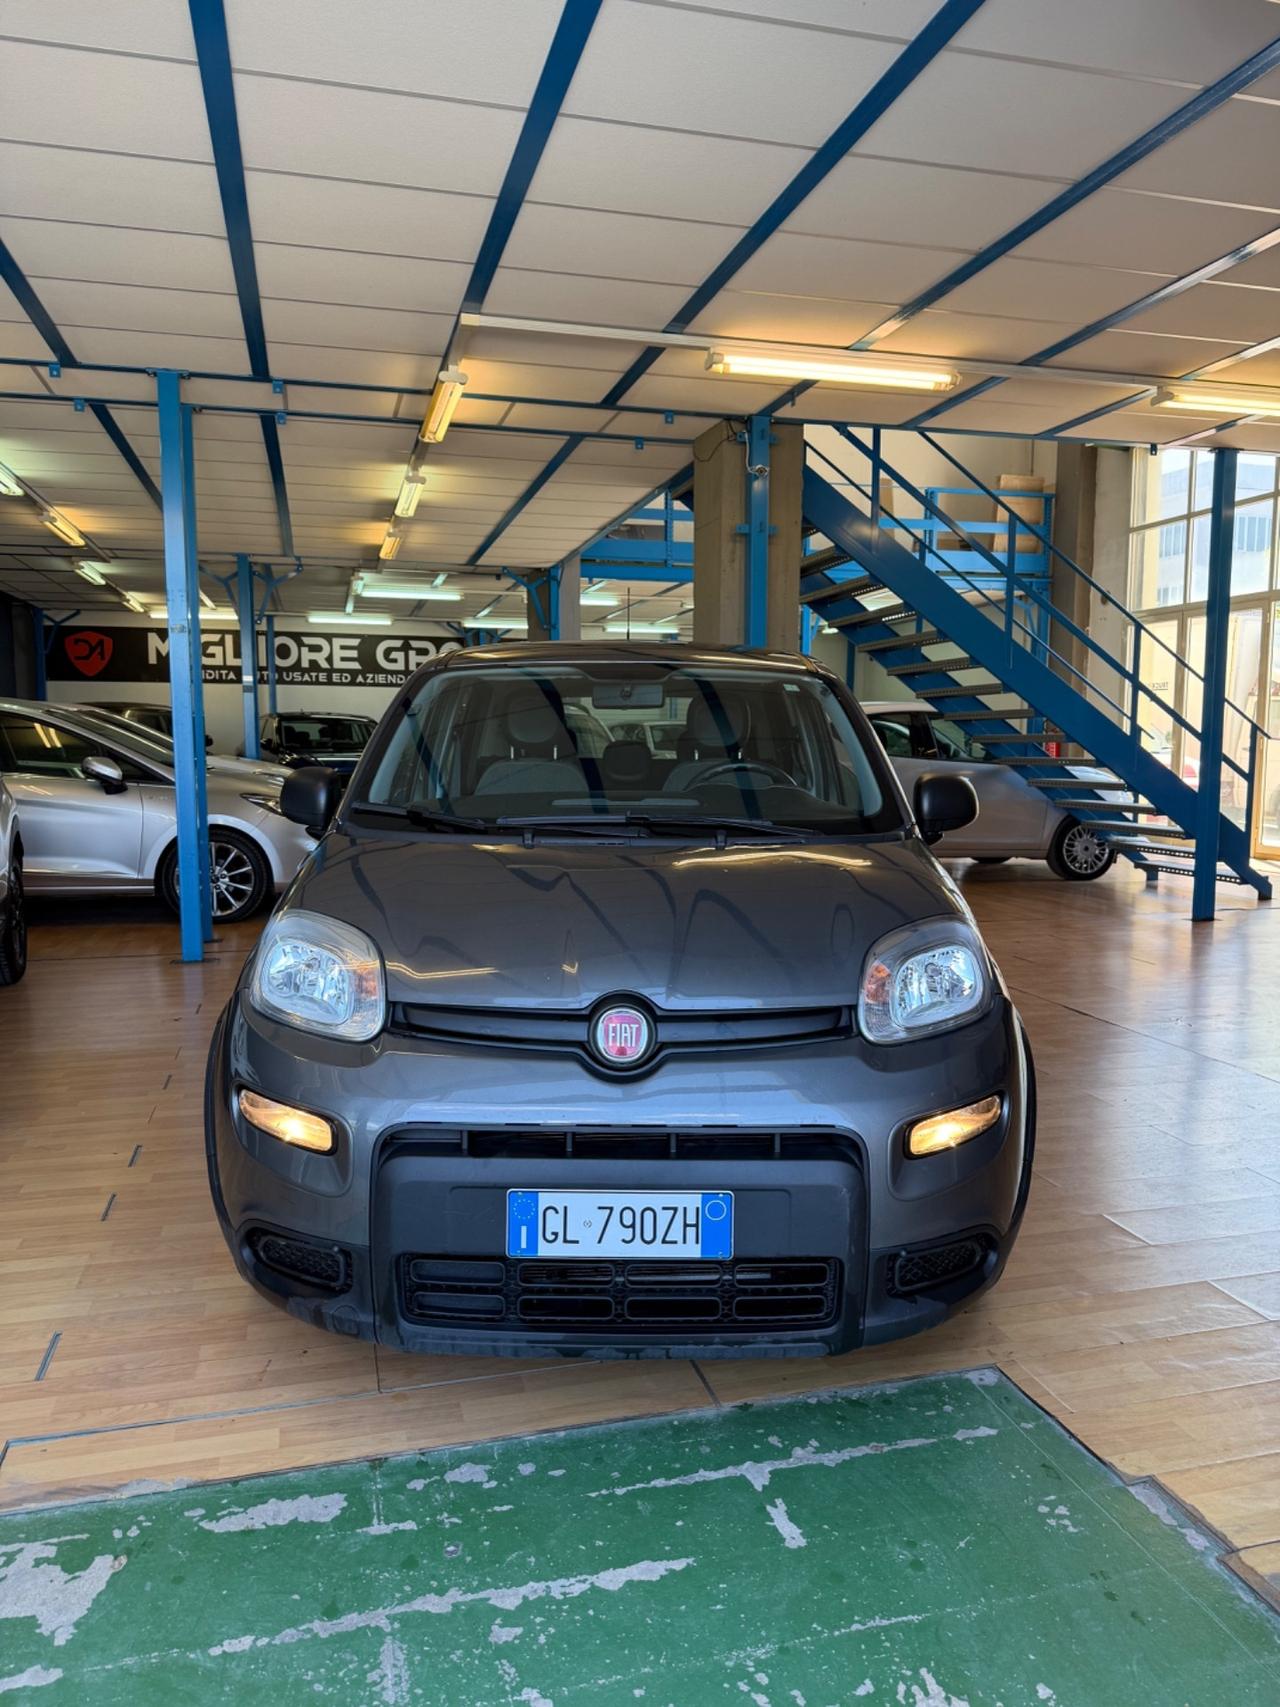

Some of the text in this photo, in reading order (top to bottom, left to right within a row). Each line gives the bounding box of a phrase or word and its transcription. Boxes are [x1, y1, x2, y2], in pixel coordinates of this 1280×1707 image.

[147, 632, 362, 669] MGLIORE
[283, 671, 328, 682] USATE
[332, 673, 351, 683] ED
[355, 673, 410, 684] AZIEND
[608, 1023, 640, 1048] FIAT
[542, 1205, 700, 1245] GL 790ZH
